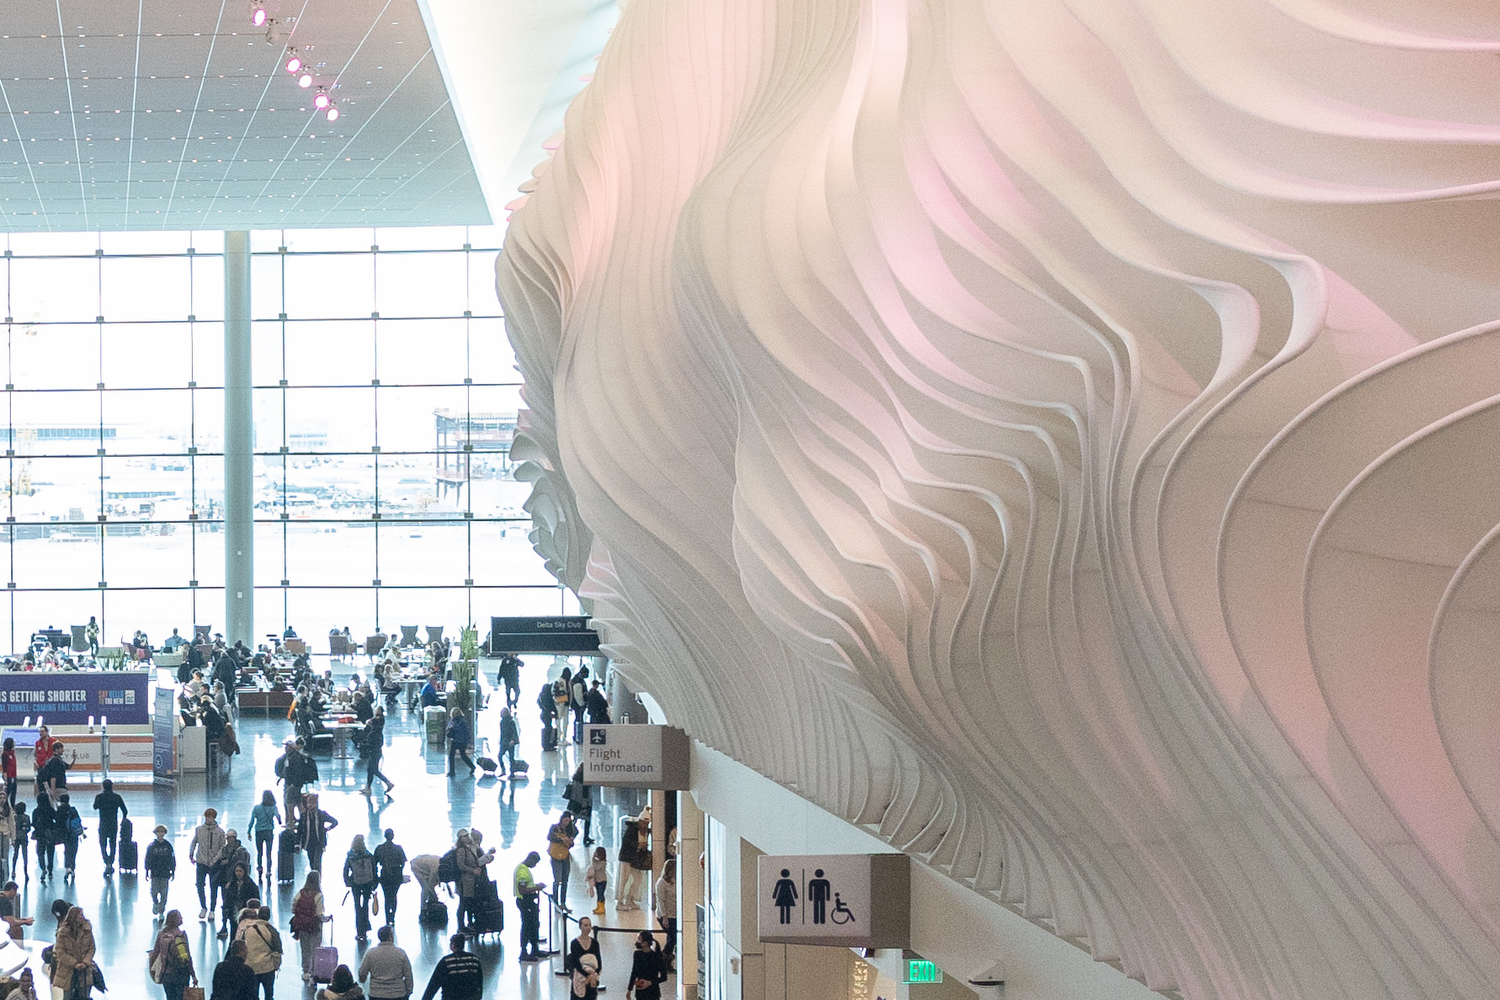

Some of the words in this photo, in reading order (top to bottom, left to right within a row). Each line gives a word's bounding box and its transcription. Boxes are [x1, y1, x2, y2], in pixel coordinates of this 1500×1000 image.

[536, 621, 553, 629] Delta
[554, 621, 566, 630] Sky
[567, 621, 582, 629] Club
[9, 689, 45, 703] GETTING
[47, 689, 87, 702] SHORTER
[589, 748, 621, 761] Flight
[589, 761, 654, 773] Information
[909, 960, 936, 982] EXIT
